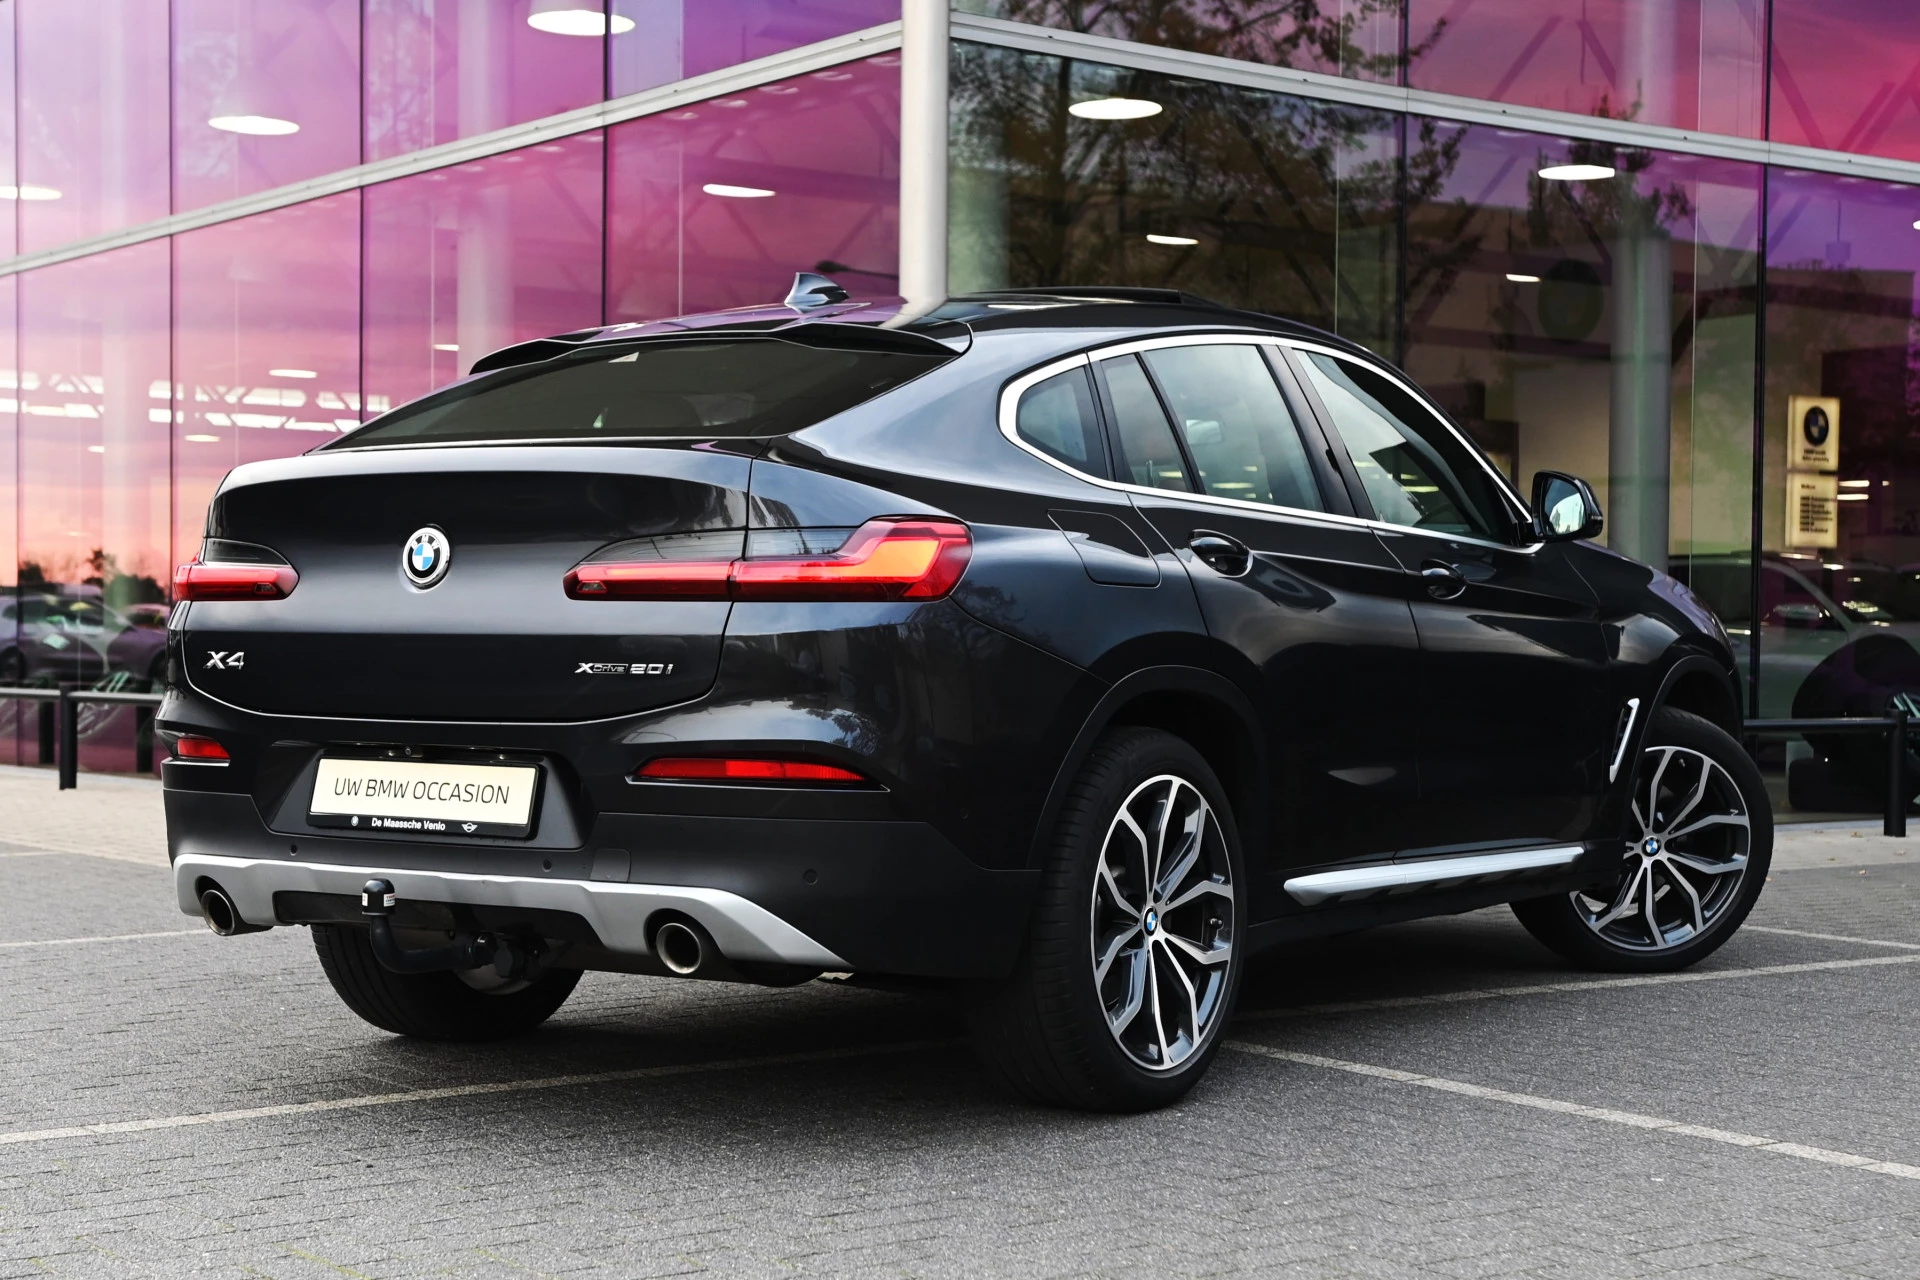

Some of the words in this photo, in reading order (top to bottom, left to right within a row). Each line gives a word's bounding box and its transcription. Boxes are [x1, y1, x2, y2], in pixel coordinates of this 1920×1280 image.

[202, 650, 244, 670] X4
[334, 777, 362, 797] UW
[365, 778, 409, 799] BMW
[412, 780, 510, 805] OCCASION
[371, 817, 383, 828] De
[383, 818, 421, 830] Maassche
[423, 820, 446, 831] Venlo
